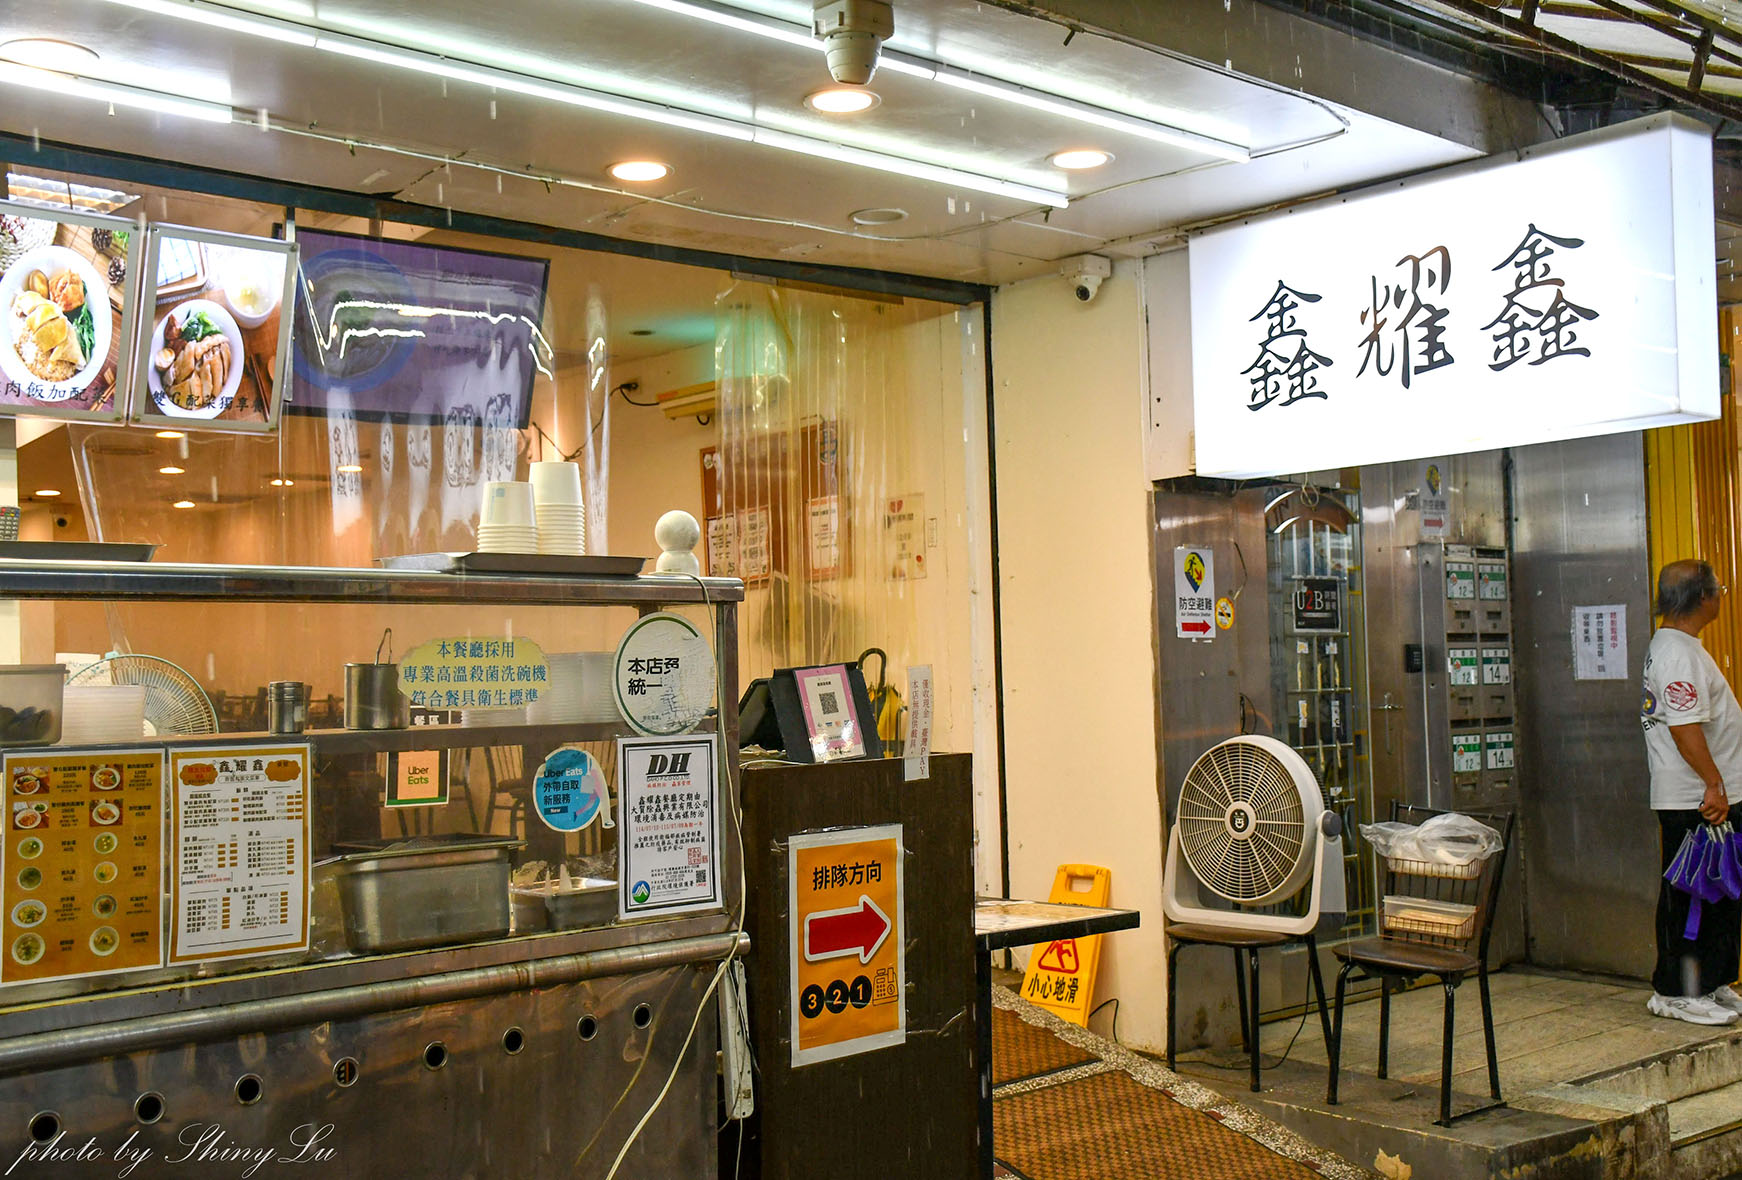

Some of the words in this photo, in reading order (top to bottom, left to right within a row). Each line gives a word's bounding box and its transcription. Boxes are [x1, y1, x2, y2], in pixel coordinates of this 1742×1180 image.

[1240, 223, 1600, 412] 鑫耀鑫
[0, 380, 108, 405] 肉飯加配菜
[1179, 597, 1213, 611] 防空避難
[1296, 590, 1324, 610] U2B
[436, 641, 515, 659] 本餐廳採用
[403, 664, 547, 683] 專業高溫殺菌洗碗機
[1489, 665, 1501, 683] 14
[627, 678, 663, 696] 統一
[411, 688, 539, 708] 符合餐具衛生標準
[646, 752, 692, 775] DH
[1493, 750, 1505, 767] 14
[407, 766, 429, 775] Uber
[543, 769, 565, 778] Uber
[565, 767, 583, 777] Eats
[407, 776, 429, 785] Eats
[543, 780, 579, 793] 外帶自取
[543, 793, 571, 806] 新服務
[812, 860, 882, 892] 排隊方向
[808, 993, 817, 1010] 3
[832, 988, 842, 1005] 2
[856, 984, 864, 1001] 1
[1028, 973, 1079, 1004] 小心地滑
